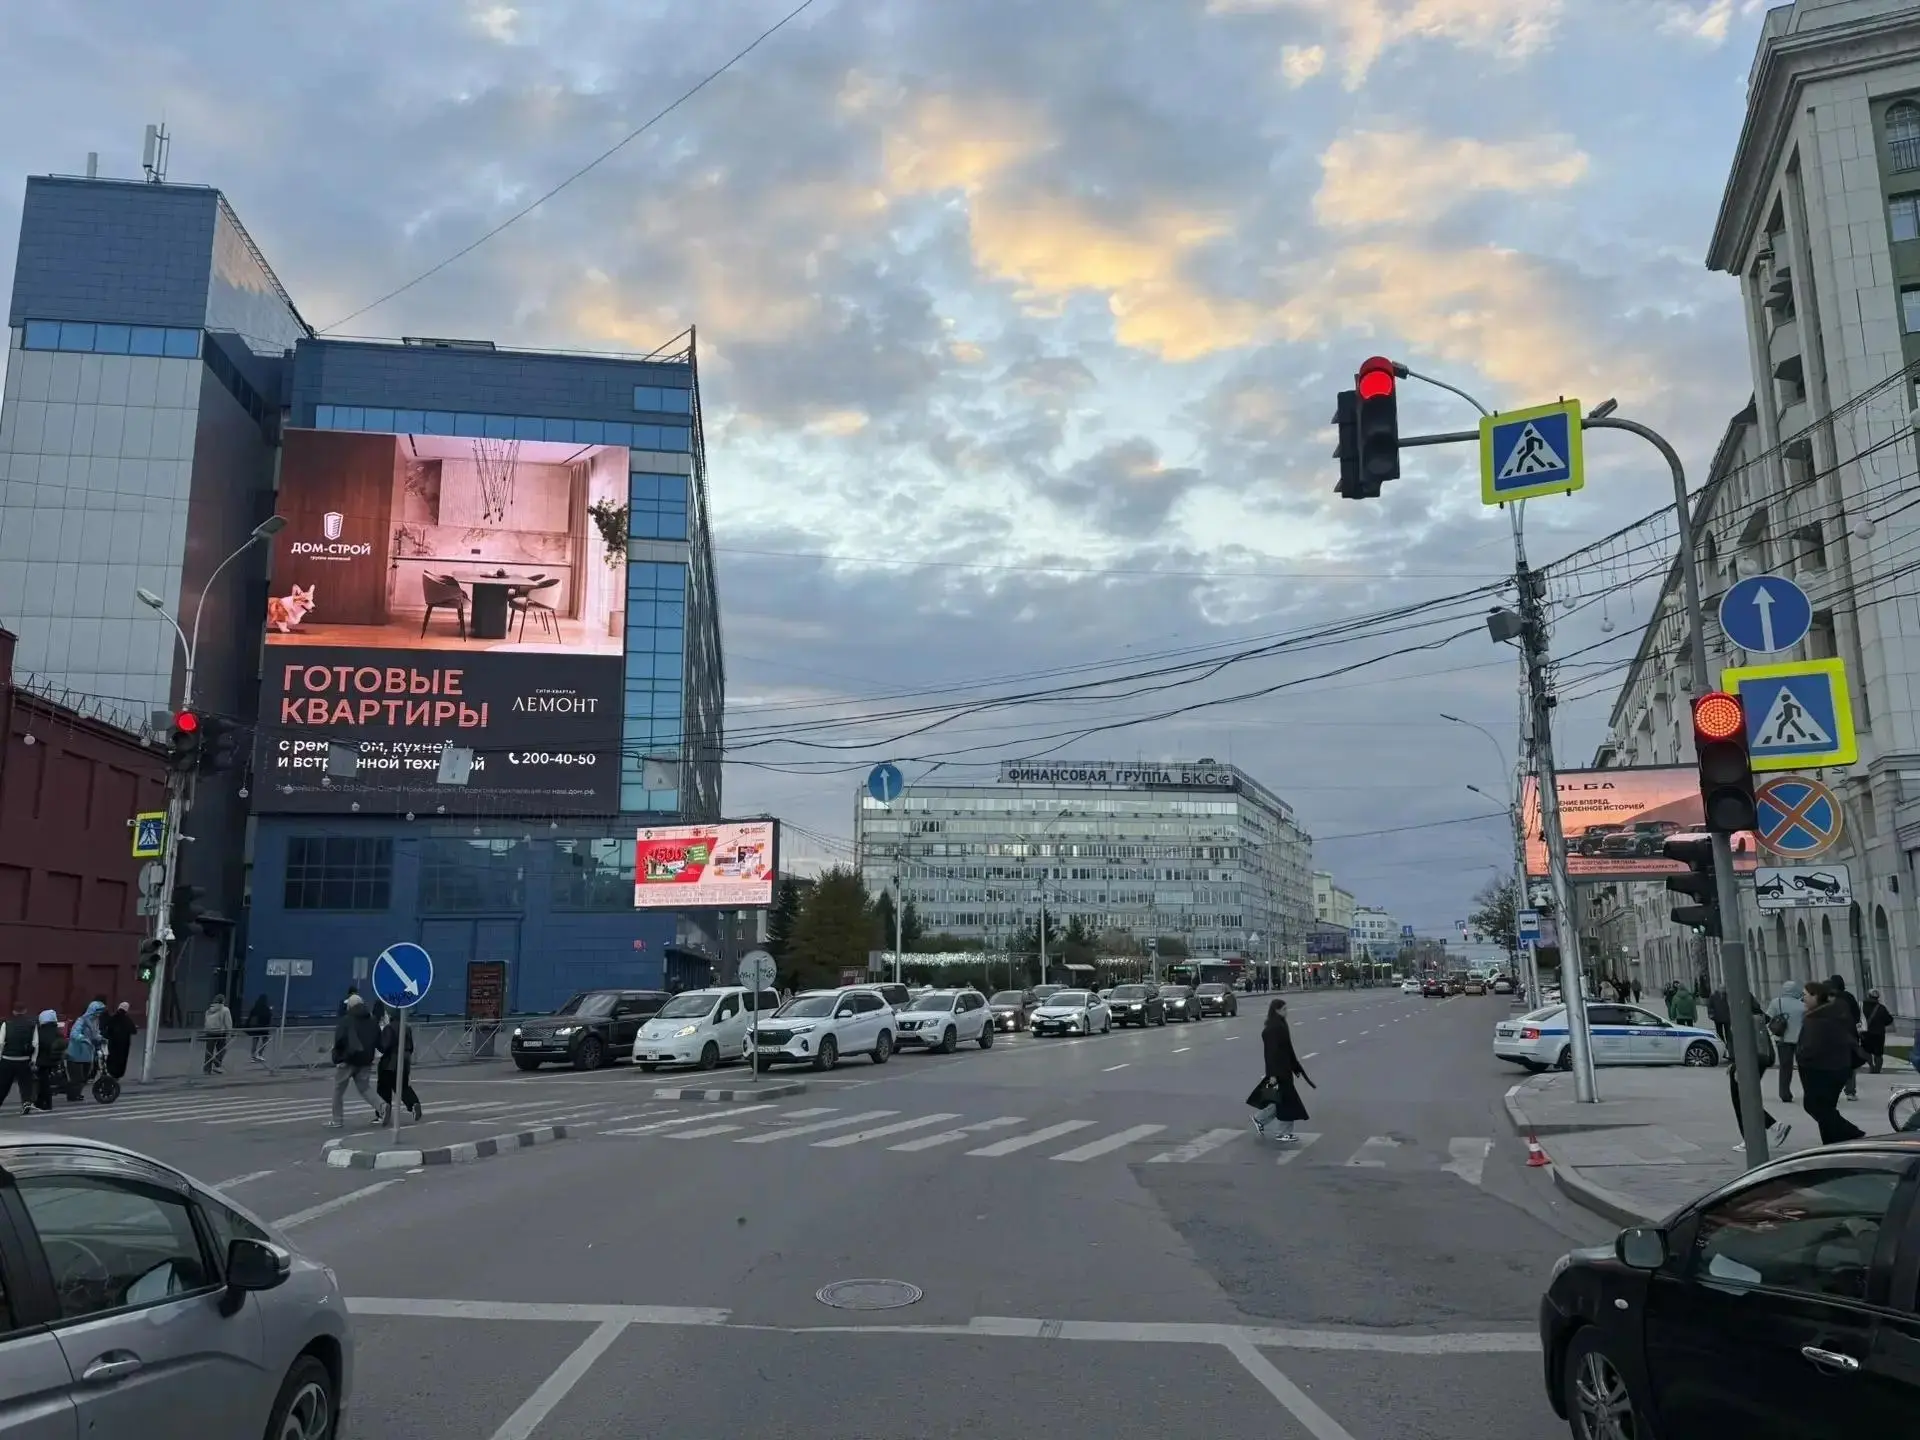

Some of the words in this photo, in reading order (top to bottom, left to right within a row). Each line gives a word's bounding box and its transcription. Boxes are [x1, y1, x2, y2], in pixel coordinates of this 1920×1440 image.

[291, 542, 371, 555] ДОМ-СТРОЙ
[283, 664, 464, 695] ГОТОВЫЕ
[511, 696, 599, 713] ЛЕМОНТ
[281, 697, 489, 728] КВАРТИРЫ
[279, 740, 290, 750] с
[278, 757, 288, 768] и
[522, 752, 596, 765] 200-40-50
[1008, 769, 1107, 782] ФИНАНСОВАЯ
[1116, 770, 1171, 783] ГРУППА
[1181, 772, 1216, 785] БКС
[1603, 802, 1645, 811] ИСТОРИЕЙ
